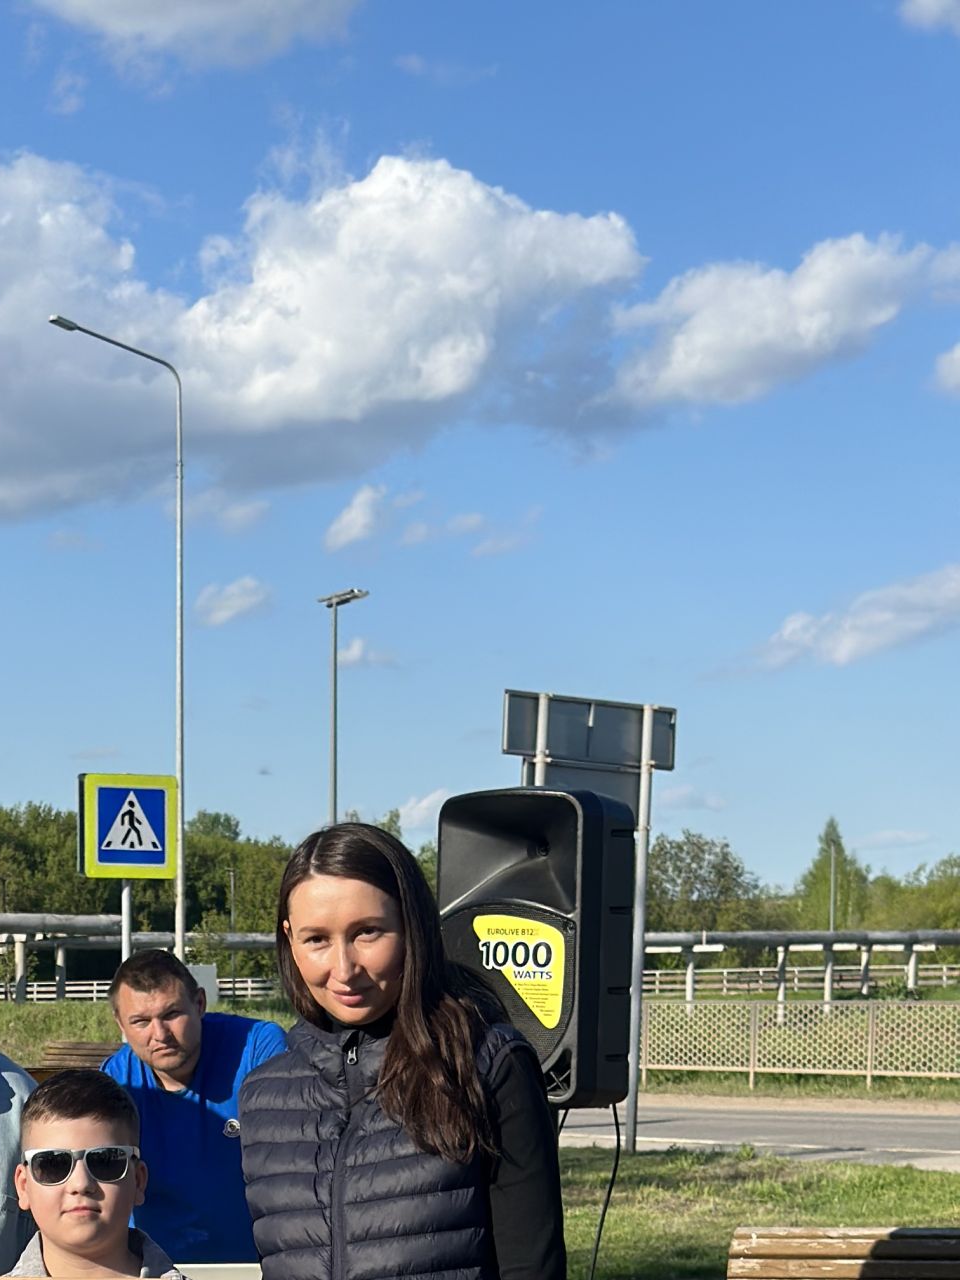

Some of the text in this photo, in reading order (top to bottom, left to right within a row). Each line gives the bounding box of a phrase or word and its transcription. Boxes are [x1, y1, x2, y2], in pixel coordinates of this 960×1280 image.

[487, 928, 519, 936] EUROLIVE
[481, 941, 552, 968] 1000
[513, 970, 552, 979] WATTS
